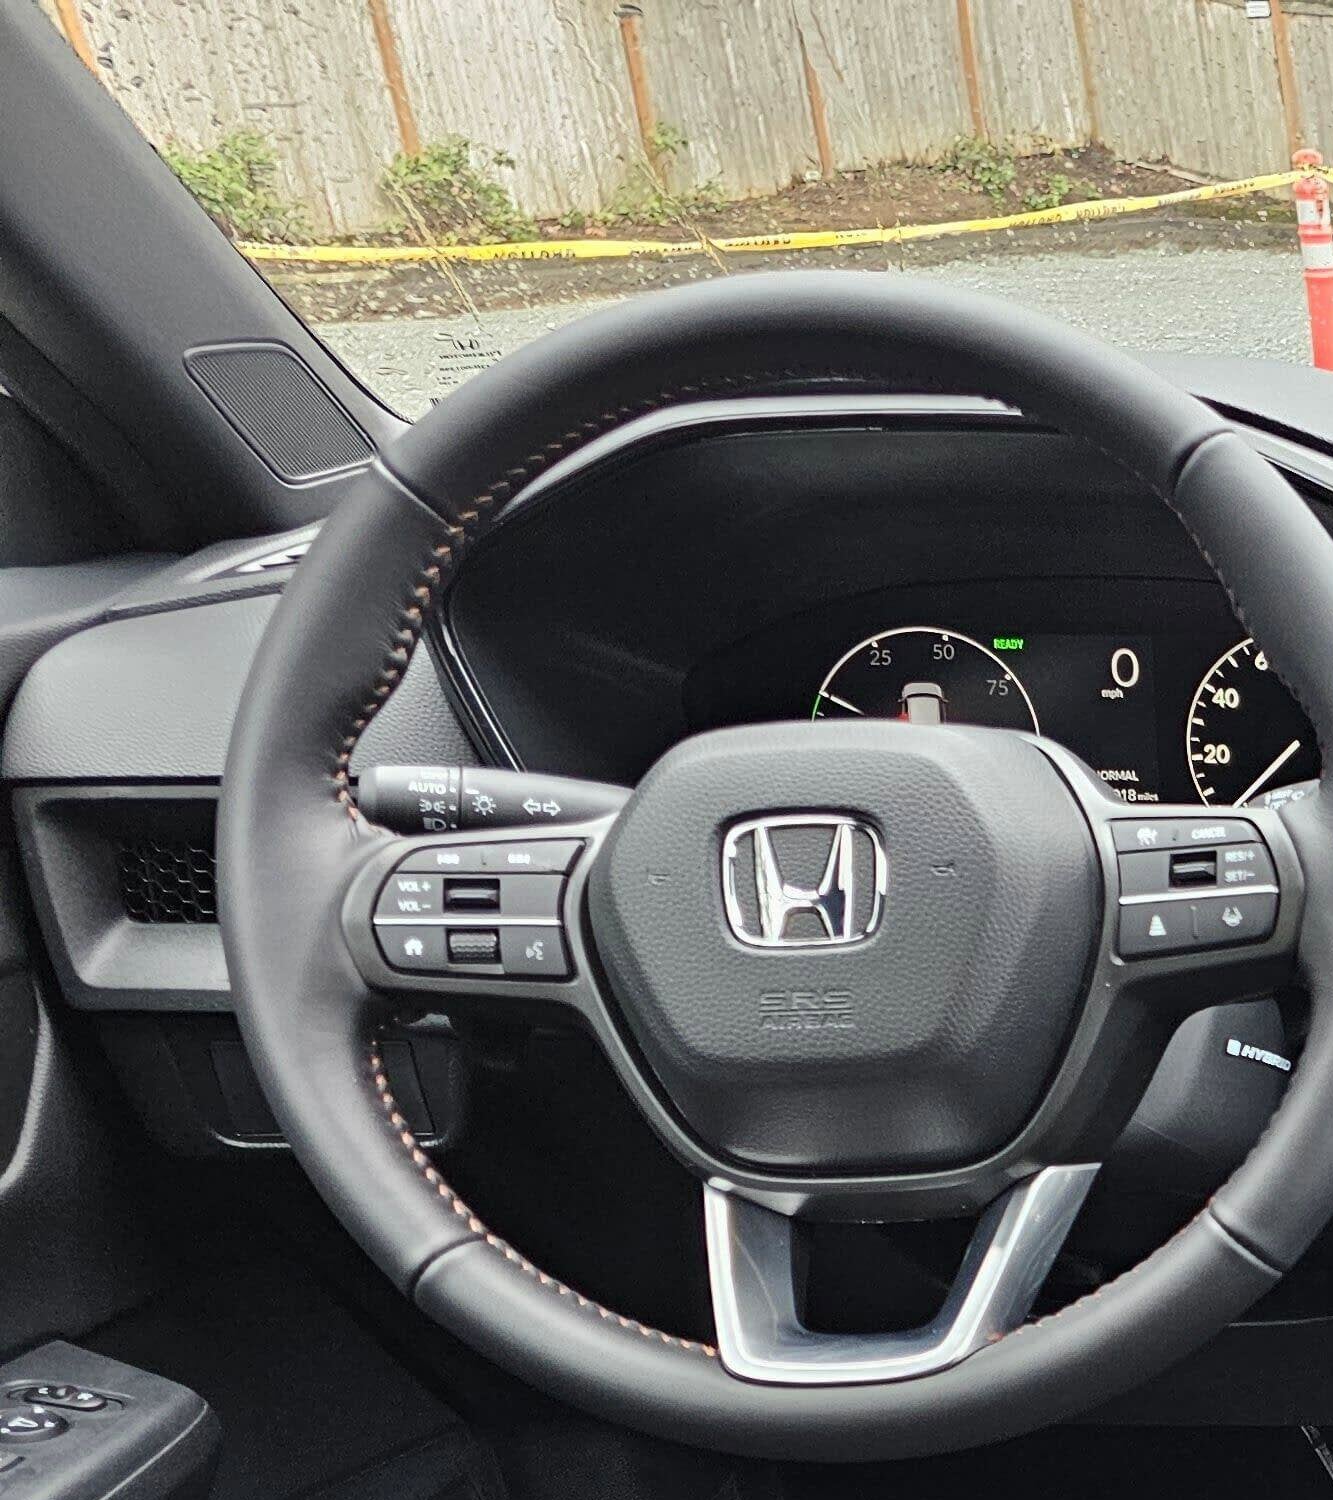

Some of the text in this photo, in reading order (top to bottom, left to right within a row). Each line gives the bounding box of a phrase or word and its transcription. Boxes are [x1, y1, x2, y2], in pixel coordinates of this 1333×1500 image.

[993, 638, 1024, 650] READY
[869, 650, 892, 666] 25
[933, 644, 954, 660] 50
[1254, 651, 1268, 670] 6
[1111, 648, 1140, 688] 0
[986, 679, 1009, 696] 75
[1101, 688, 1124, 699] mph
[1212, 688, 1240, 709] 40
[1203, 744, 1231, 764] 20
[1096, 770, 1139, 782] ORMAL
[408, 782, 447, 795] AUTO
[1137, 791, 1159, 801] miles
[398, 881, 421, 893] VOL
[398, 900, 421, 912] VOL
